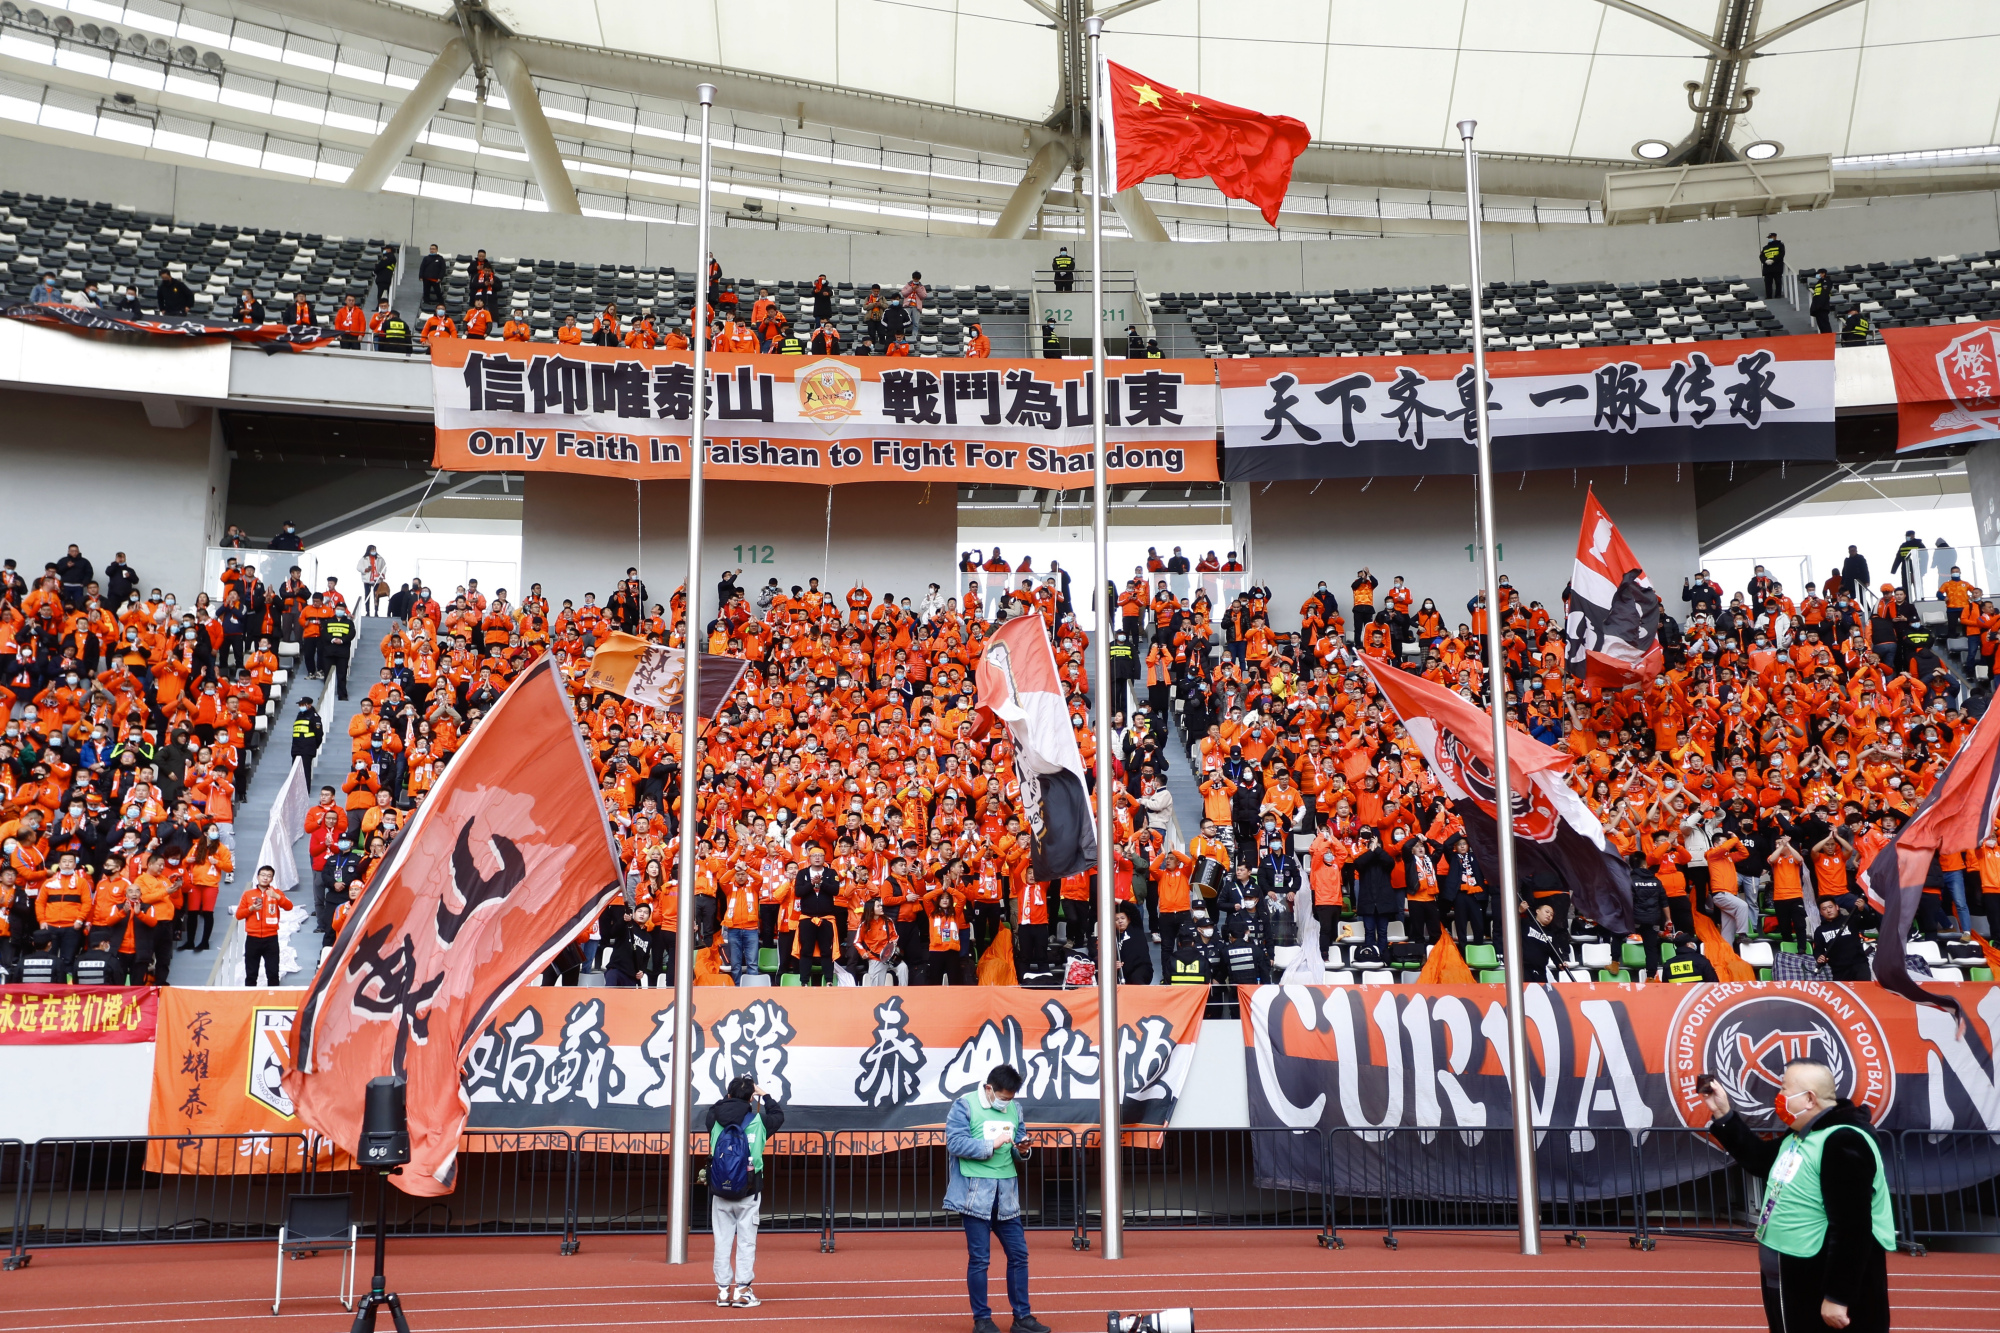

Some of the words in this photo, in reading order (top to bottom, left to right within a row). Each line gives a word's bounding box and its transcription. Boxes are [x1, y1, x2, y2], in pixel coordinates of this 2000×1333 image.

[1045, 309, 1073, 321] 212
[464, 352, 775, 423] 信仰唯泰山
[469, 431, 545, 460] Only
[557, 433, 639, 462] Faith
[651, 438, 681, 462] In
[829, 442, 862, 466] to
[873, 441, 955, 471] Fight
[965, 443, 1018, 469] For
[733, 545, 774, 563] 112
[1464, 543, 1503, 562] 11
[1673, 963, 1692, 973] 执勤
[0, 993, 142, 1034] 永远在我们橙心
[1678, 981, 1745, 1071] SUPPORTERS
[176, 1010, 213, 1150] 荣耀泰山
[1250, 984, 1654, 1154] CURVA
[1849, 1021, 1884, 1110] FOOTBALL
[256, 1073, 280, 1105] SHANDONG
[1679, 1075, 1703, 1112] THE
